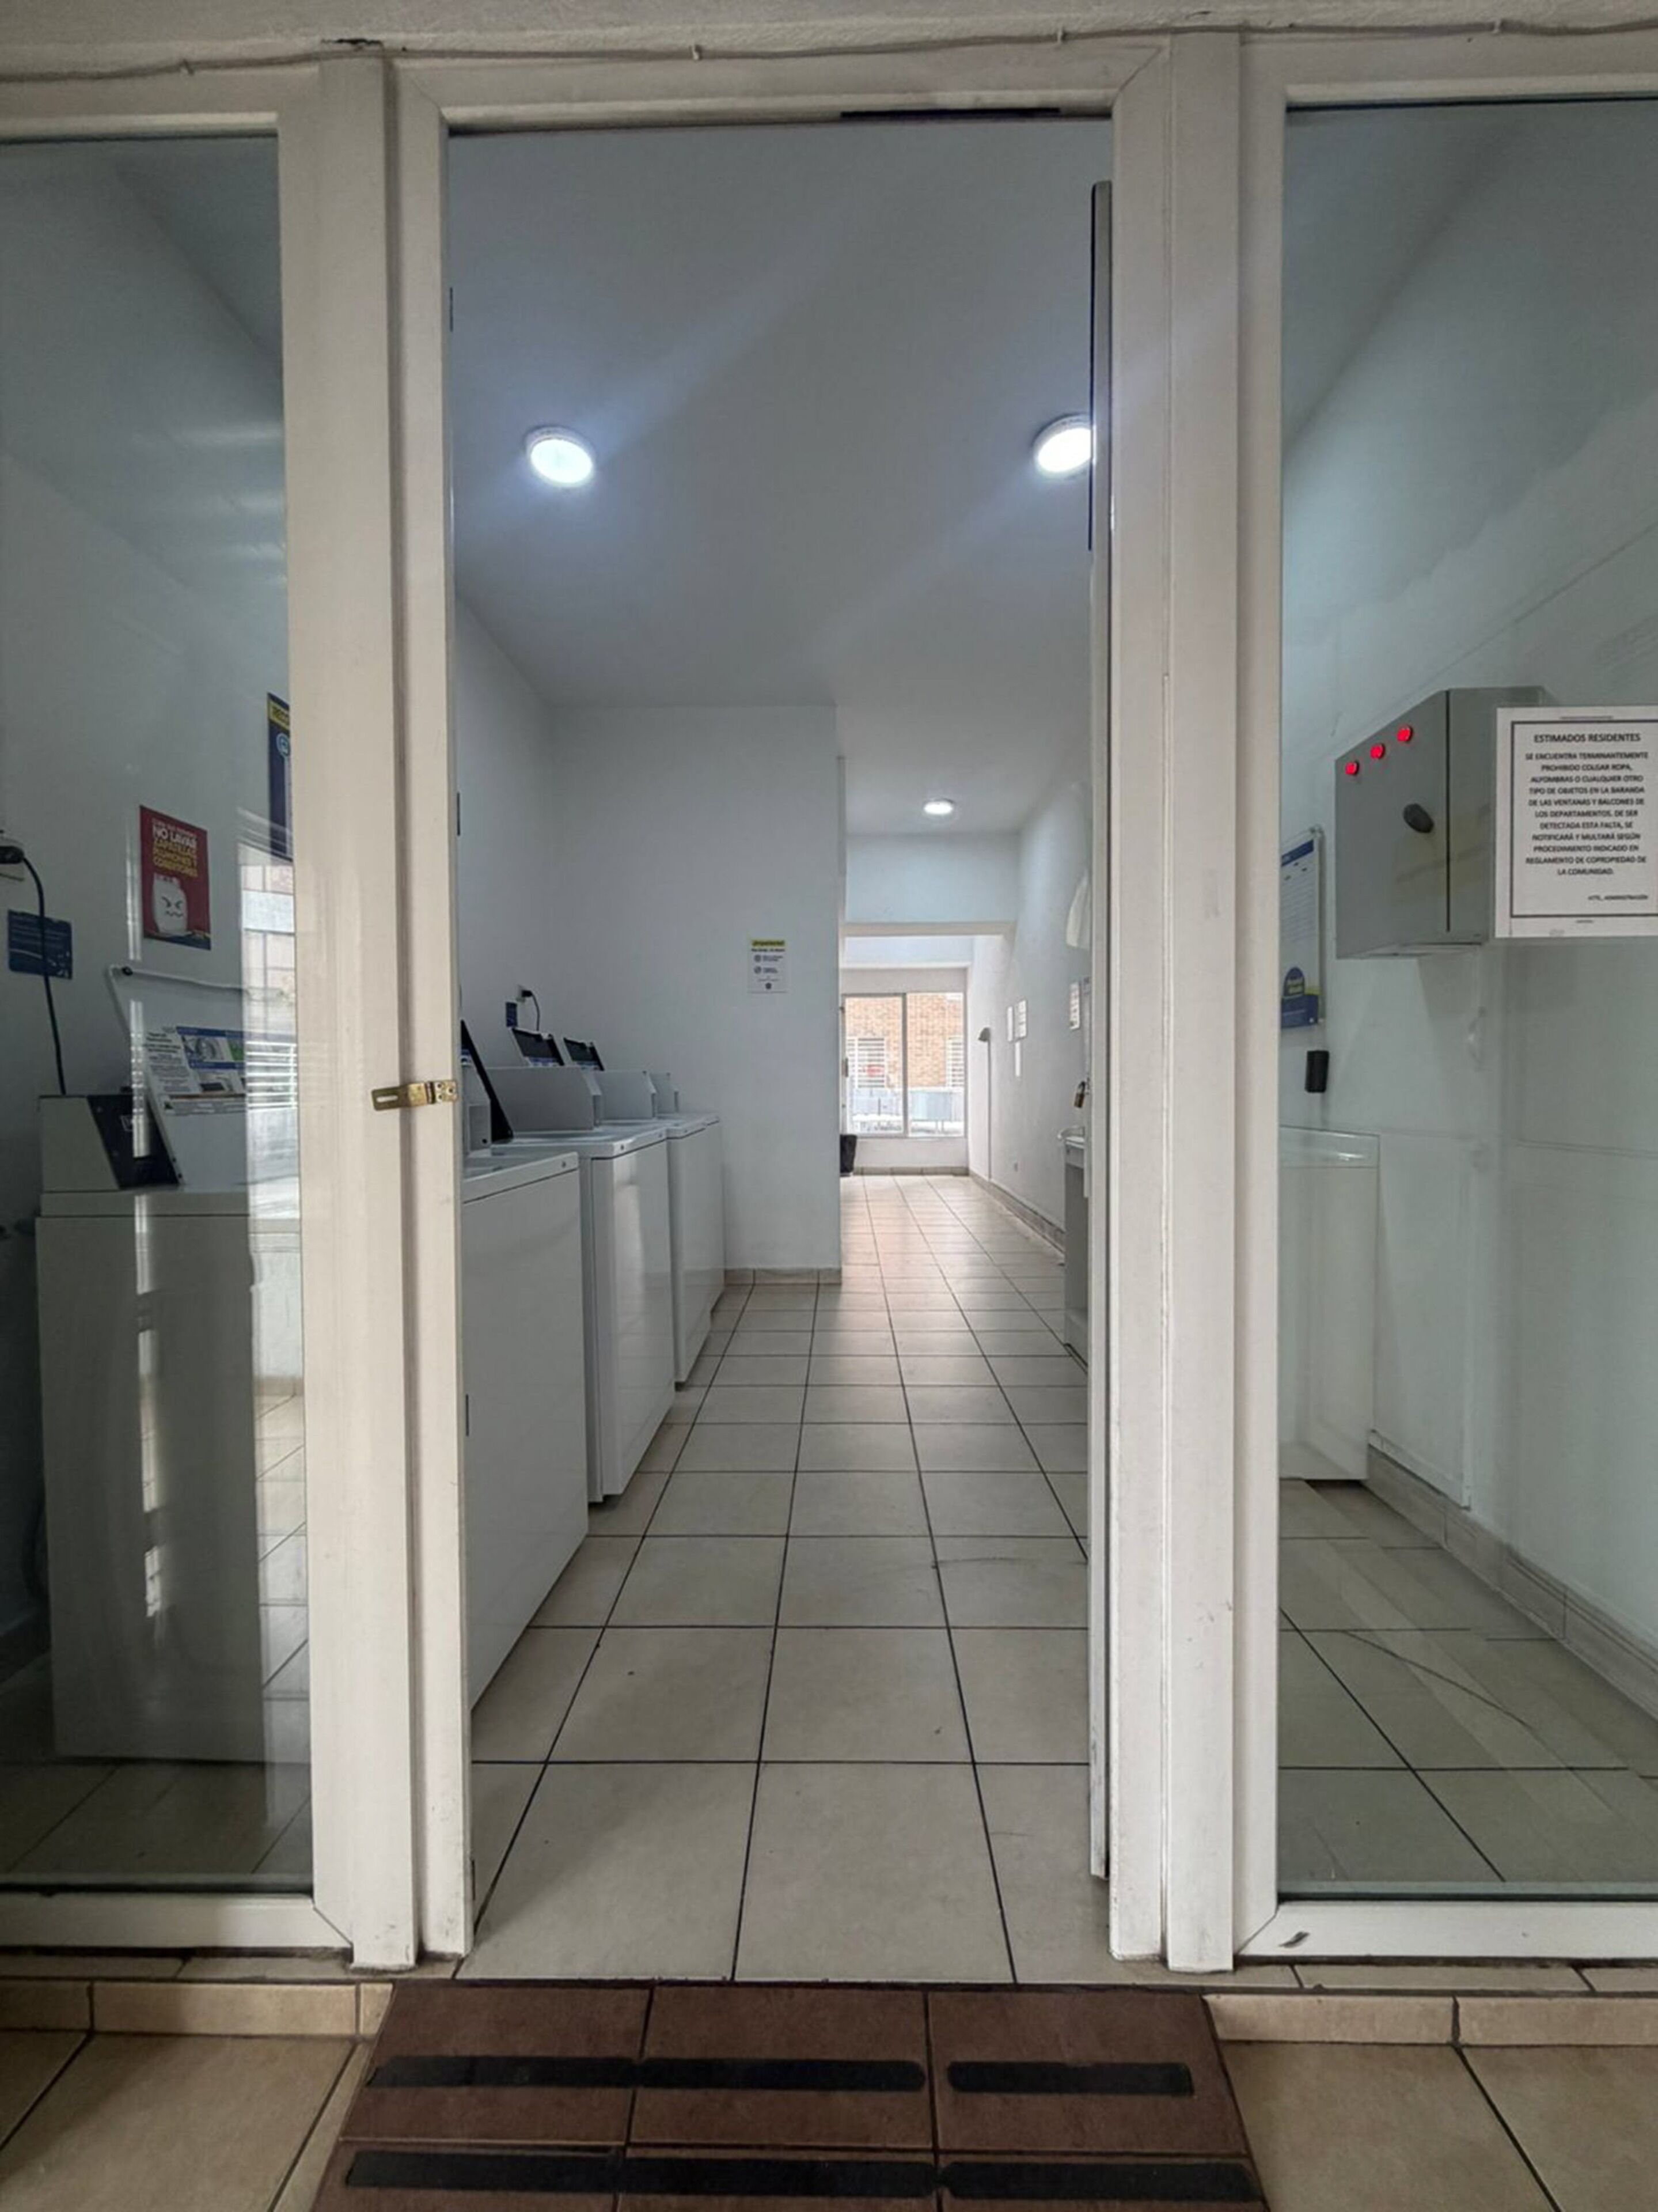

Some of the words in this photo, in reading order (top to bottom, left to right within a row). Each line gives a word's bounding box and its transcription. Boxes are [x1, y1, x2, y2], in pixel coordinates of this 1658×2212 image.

[1534, 734, 1585, 743] ESTIMADOS
[1588, 733, 1640, 742] RESIDENTES
[152, 825, 169, 840] NO
